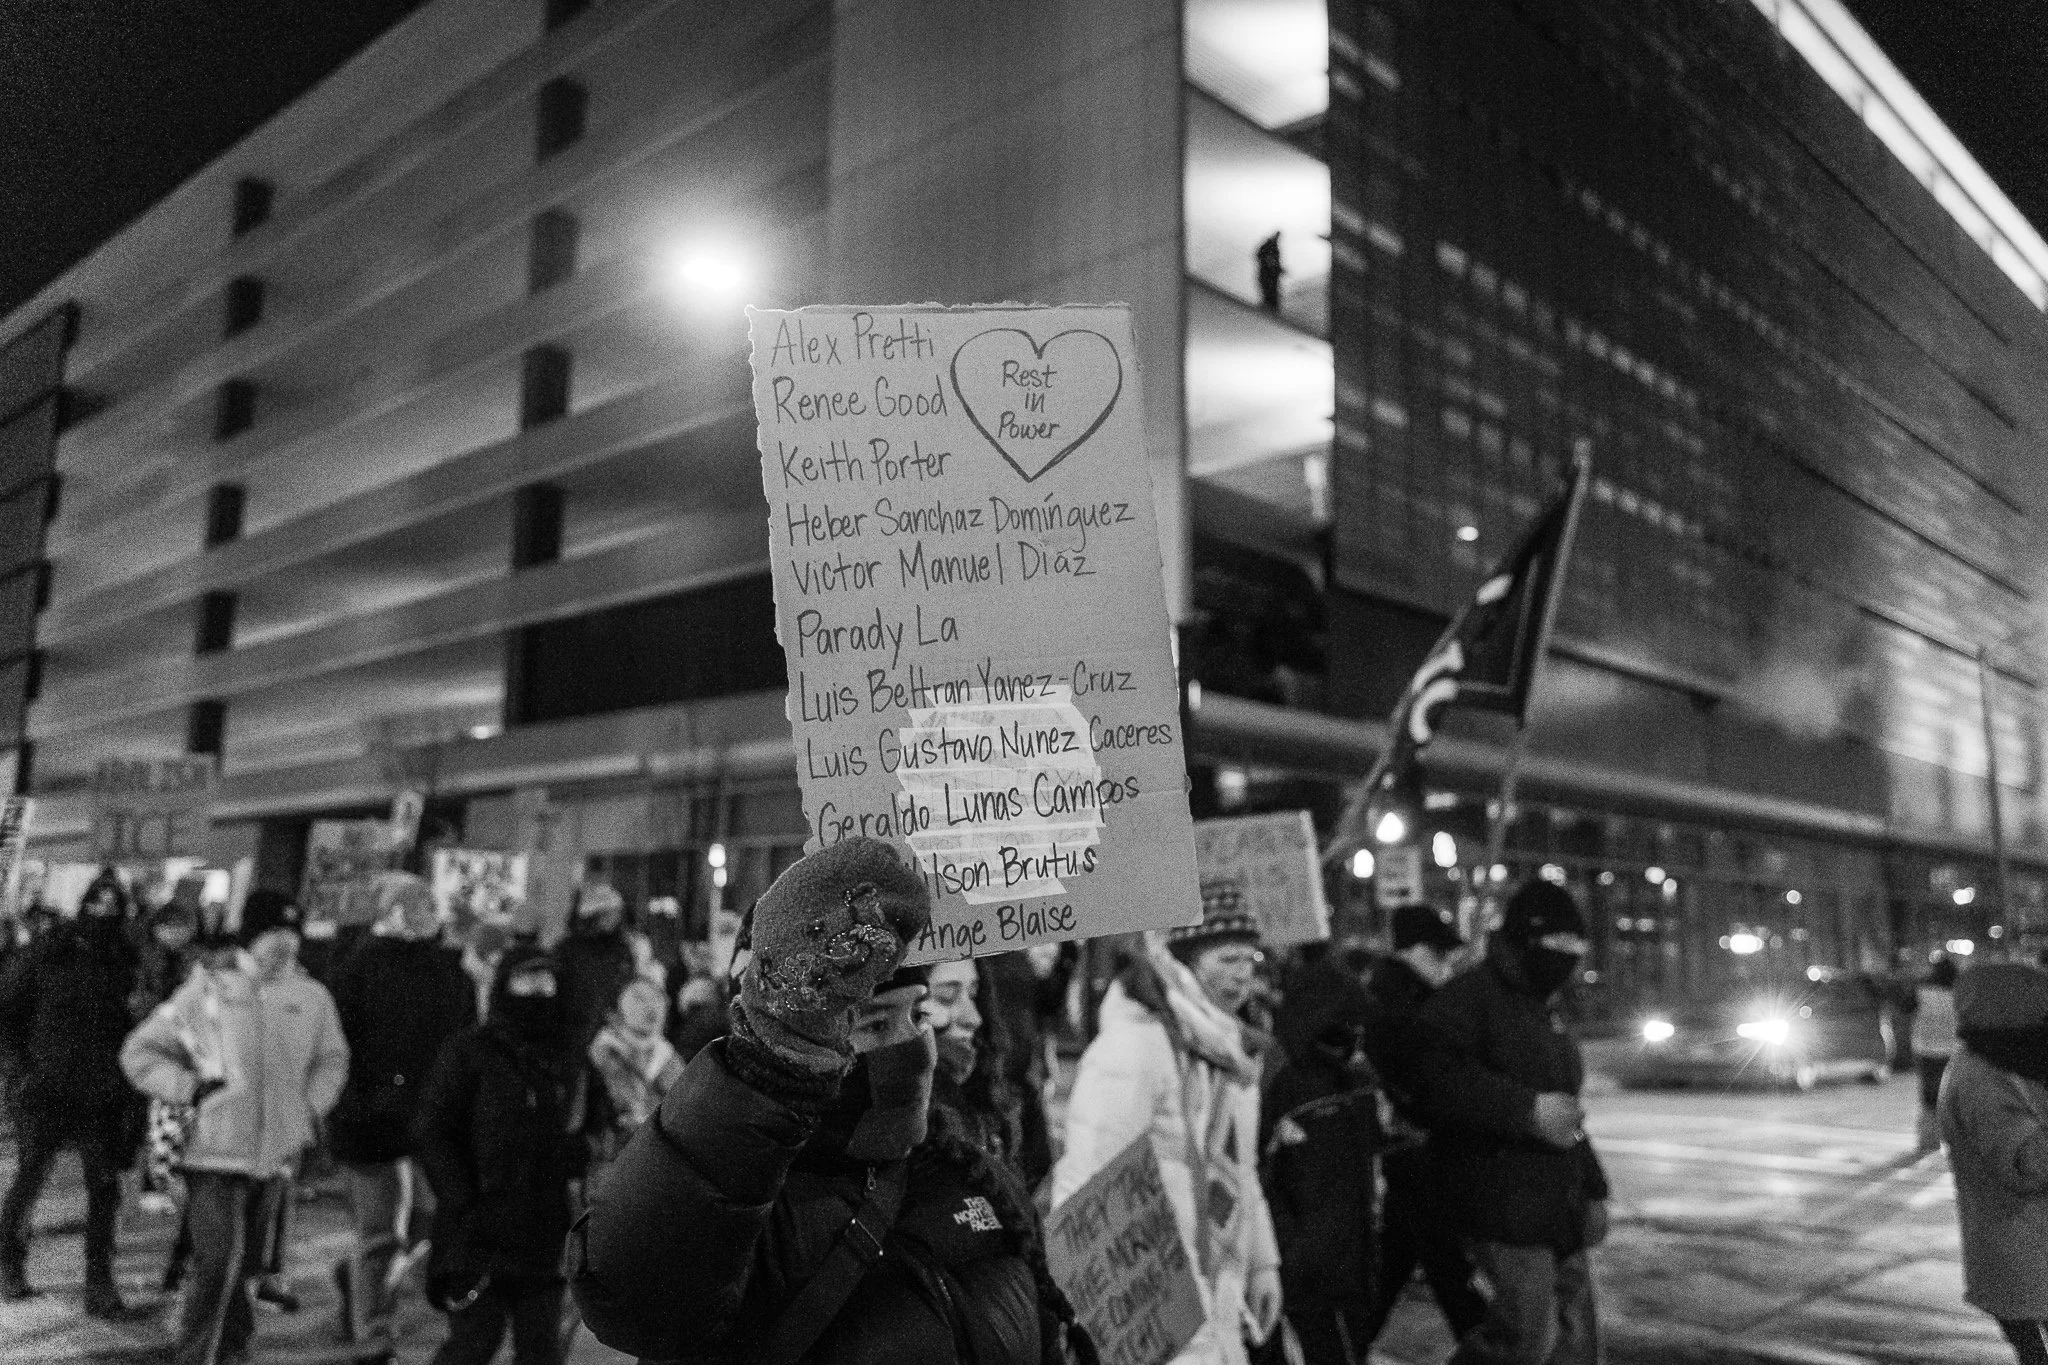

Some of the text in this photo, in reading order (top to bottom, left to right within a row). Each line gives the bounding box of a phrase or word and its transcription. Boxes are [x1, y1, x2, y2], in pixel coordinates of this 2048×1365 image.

[771, 312, 934, 367] Alex Pretti
[772, 374, 947, 424] Renee Good
[1001, 360, 1057, 389] Rest
[1024, 390, 1045, 413] in
[998, 411, 1060, 440] Power
[778, 438, 951, 488] Keith Porter
[786, 492, 1135, 552] Heber Sanchaz Domínguez
[791, 551, 881, 595] Victor
[899, 540, 1004, 592] Manuel
[797, 604, 958, 670] Parady La
[800, 671, 858, 722] Luis
[868, 665, 970, 713] Beltran
[806, 715, 1172, 779] Luis Gustavo Nunez Caceres
[818, 772, 1140, 848] Geraldo Lunas Campos
[998, 843, 1096, 888] Brutus
[918, 902, 1077, 958] Ange Blaise
